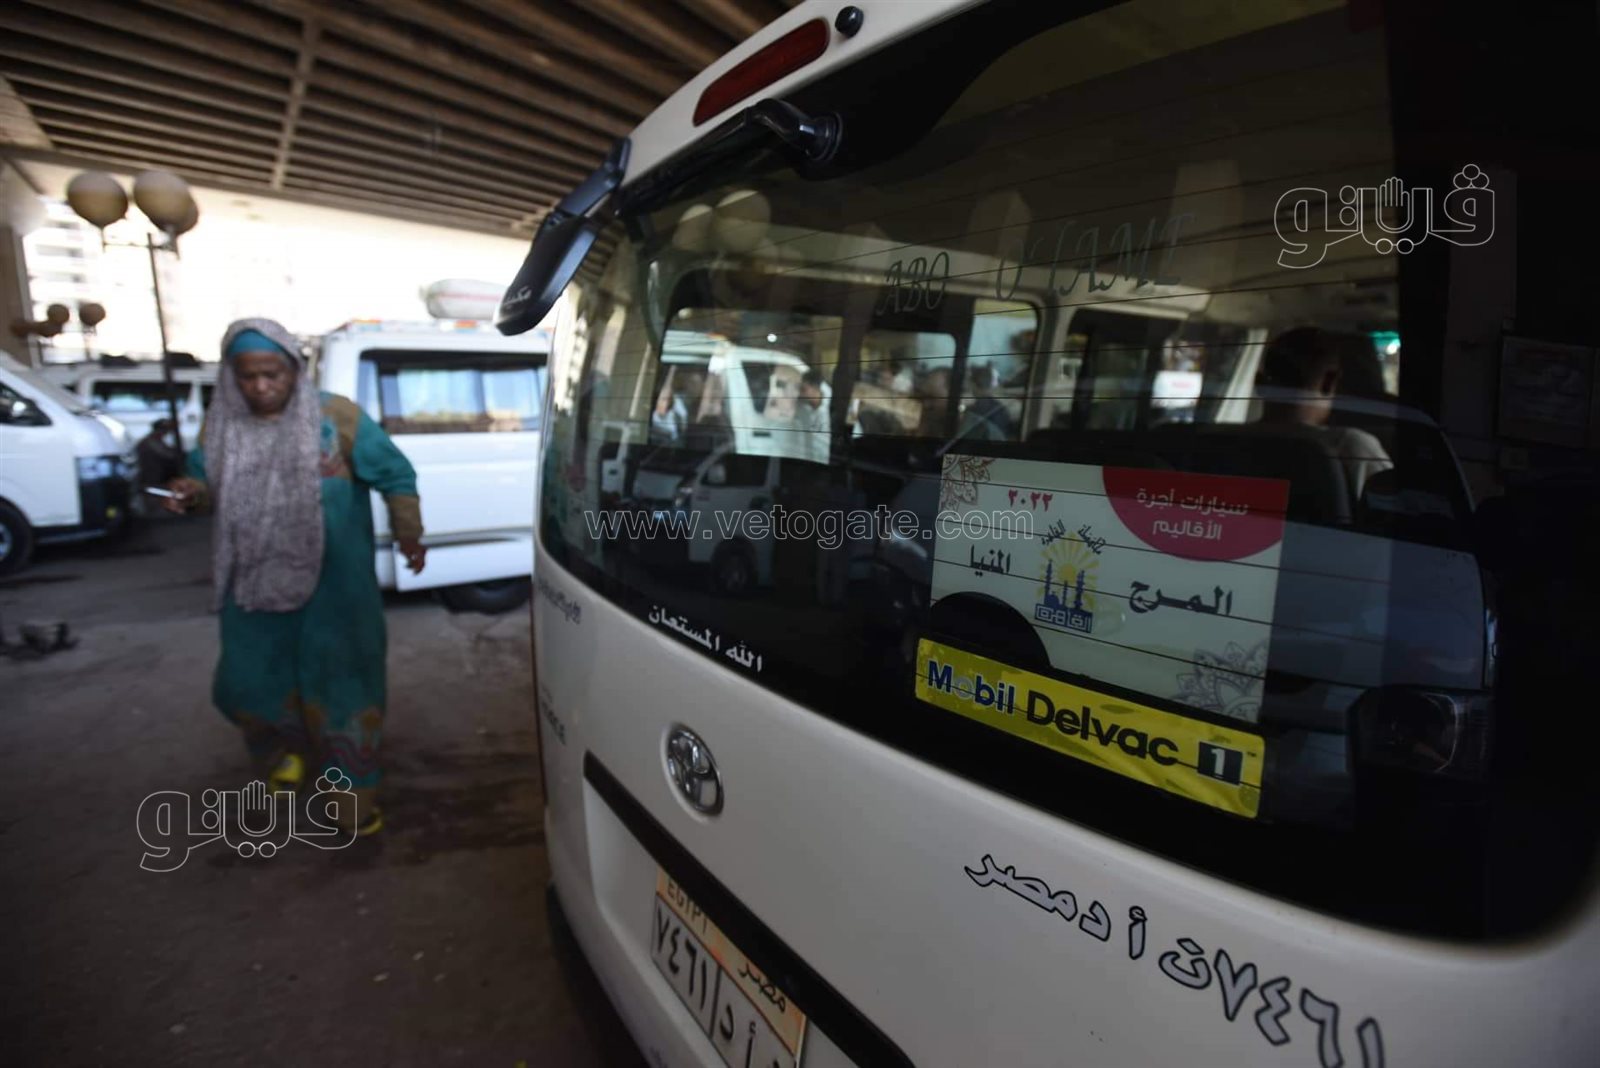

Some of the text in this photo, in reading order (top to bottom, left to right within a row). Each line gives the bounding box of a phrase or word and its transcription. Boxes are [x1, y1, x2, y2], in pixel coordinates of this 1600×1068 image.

[876, 251, 950, 317] ABO
[1007, 488, 1053, 512] ٢٠٢٢
[1136, 487, 1249, 517] سيارات أجرة
[1152, 518, 1222, 540] الأقاليم
[970, 543, 1011, 577] المنيا
[1129, 580, 1233, 616] المرج
[648, 605, 762, 672] الله المستعان
[927, 659, 1016, 715] Mobil
[1026, 689, 1179, 766] Delvac
[963, 854, 1078, 922] مصر
[1079, 900, 1112, 942] د
[655, 905, 708, 1012] ٧٤٦١
[737, 962, 787, 1014] مصر
